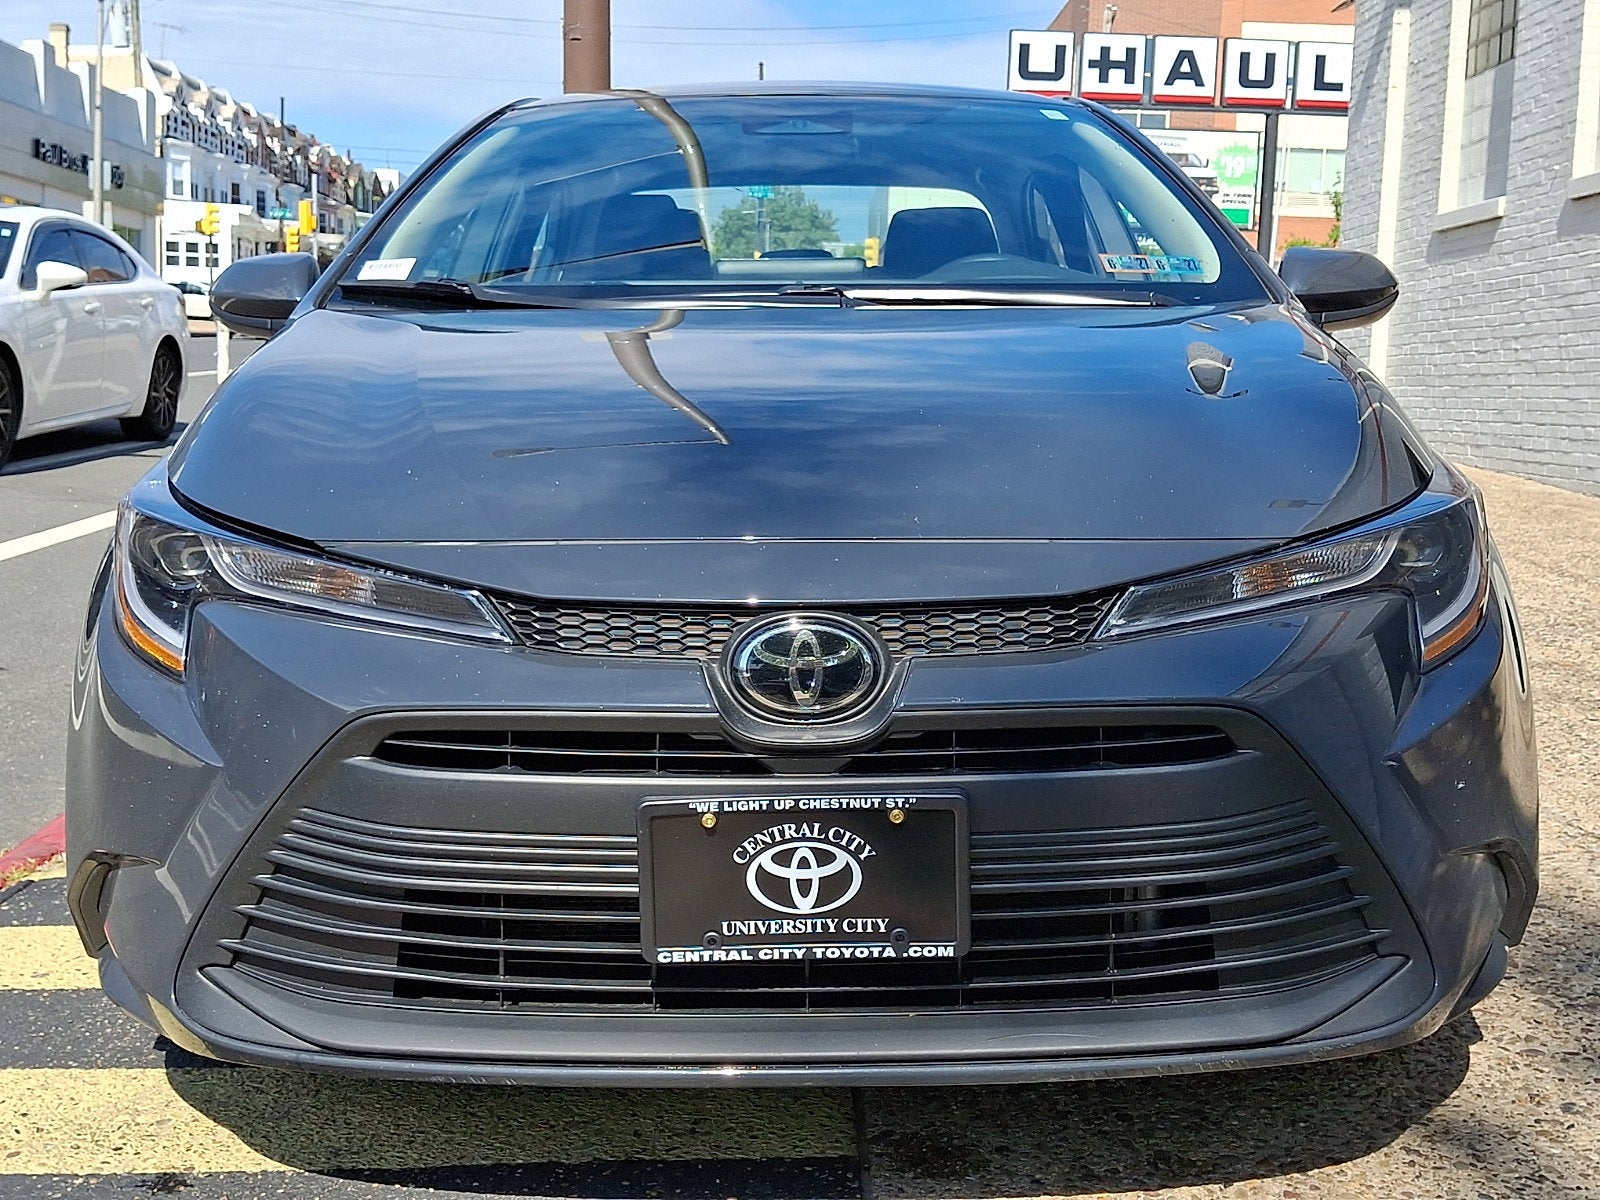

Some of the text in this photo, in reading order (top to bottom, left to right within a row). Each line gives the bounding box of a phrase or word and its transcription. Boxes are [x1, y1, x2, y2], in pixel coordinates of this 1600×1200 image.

[723, 800, 770, 812] LIGHT
[774, 800, 795, 811] UP
[798, 798, 882, 809] CHESTNUT
[732, 822, 878, 865] CENTRAL CITY
[721, 917, 890, 936] UNIVERSITY CITY
[657, 945, 955, 964] CENTRAL CITY TOYOTA .COM
